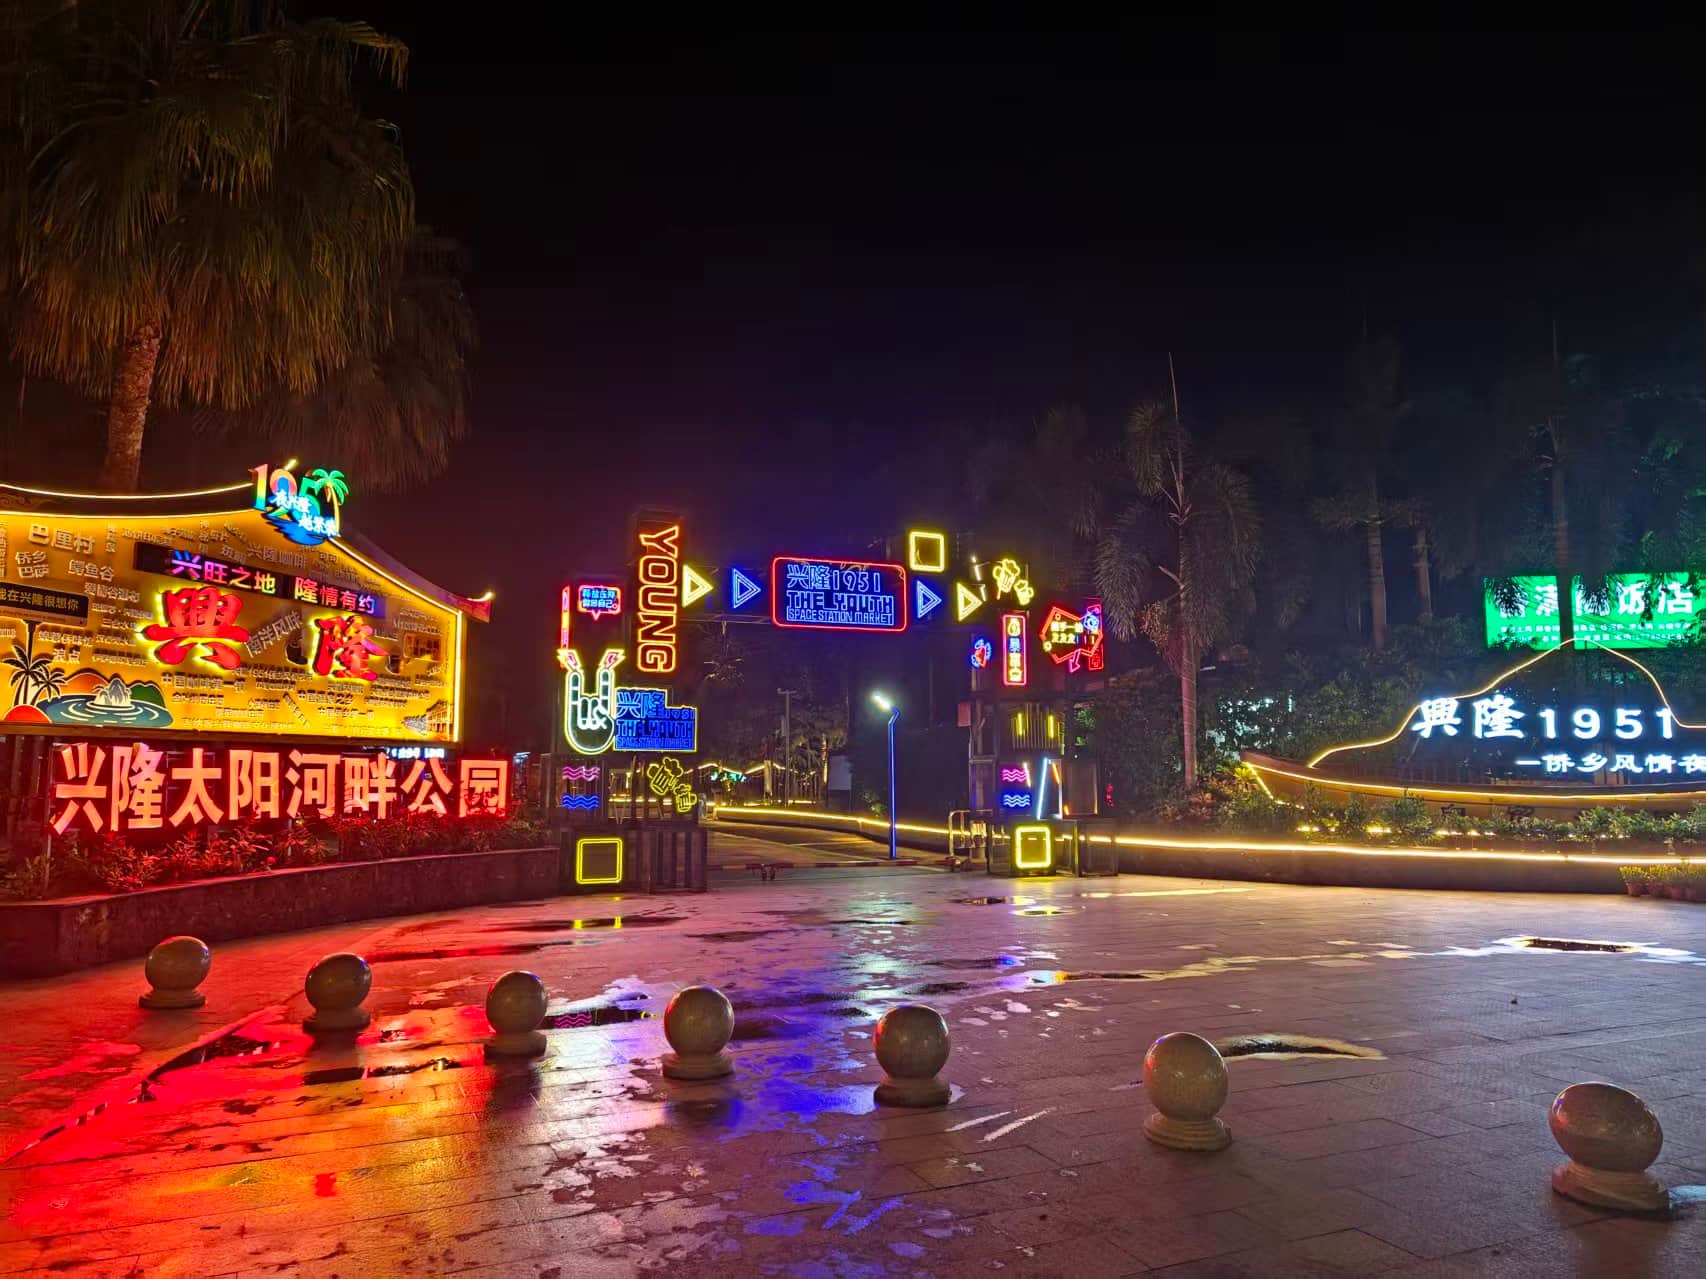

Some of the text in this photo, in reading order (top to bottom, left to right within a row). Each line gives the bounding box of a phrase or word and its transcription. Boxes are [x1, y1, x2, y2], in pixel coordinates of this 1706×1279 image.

[28, 523, 96, 555] 巴厘村
[171, 549, 276, 595] 兴旺之地
[294, 576, 375, 615] 隆情有约
[787, 564, 881, 593] 兴隆1951
[637, 525, 680, 673] YOUNG
[787, 590, 894, 613] THE YOUTH
[788, 608, 893, 624] SPACE STATION MARKET
[245, 610, 304, 658] 南洋风味
[53, 742, 508, 835] 兴隆太阳河畔公园
